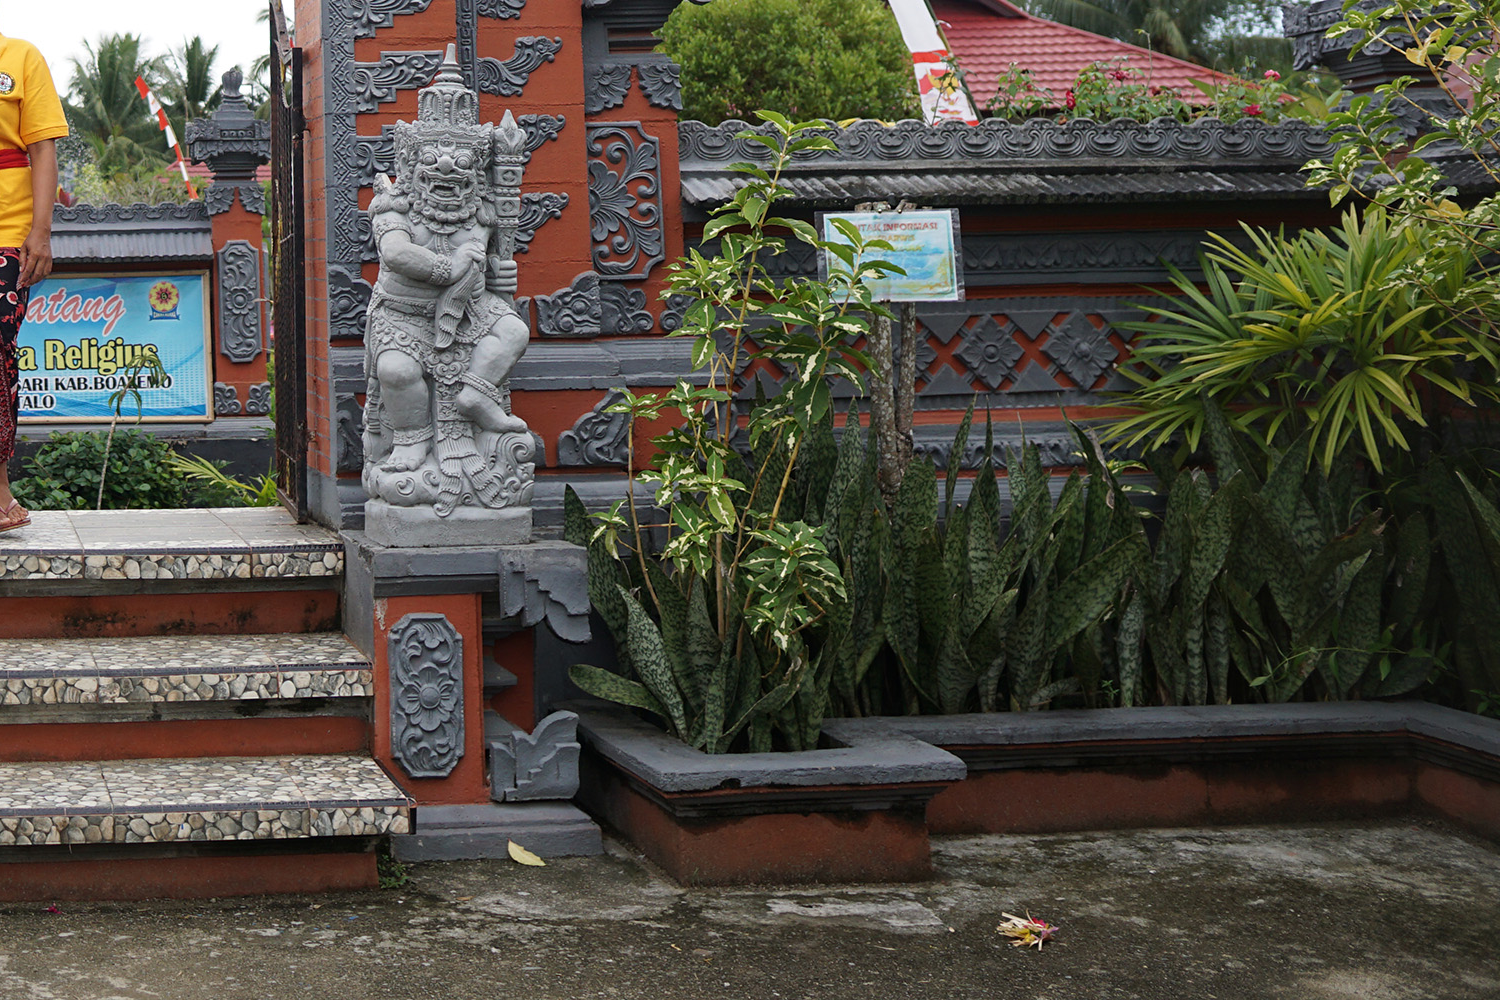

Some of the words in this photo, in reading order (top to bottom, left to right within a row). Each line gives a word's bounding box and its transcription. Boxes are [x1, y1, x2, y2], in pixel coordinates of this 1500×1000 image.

[882, 222, 938, 232] INFORMASI
[25, 287, 127, 337] atang
[44, 337, 158, 376] Religius
